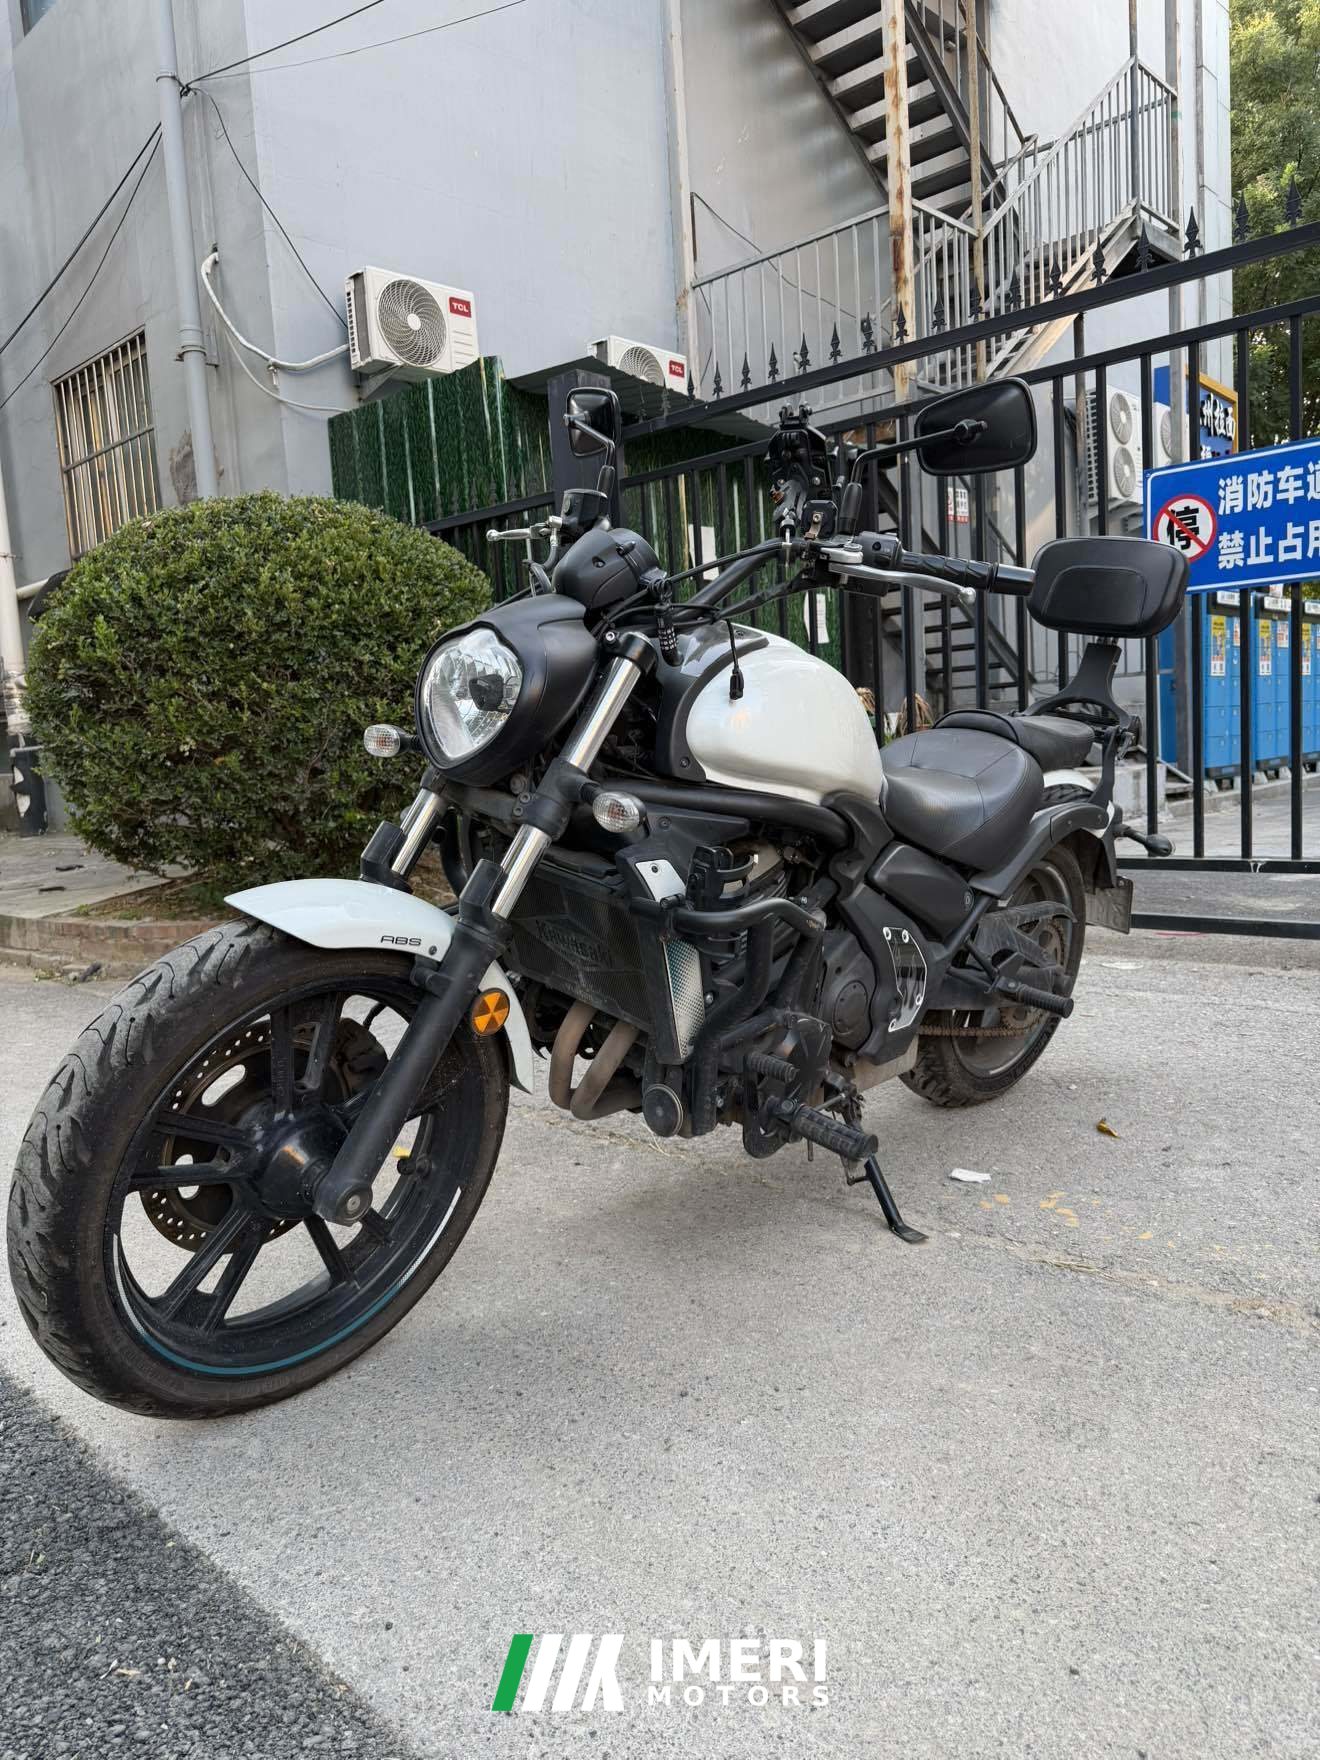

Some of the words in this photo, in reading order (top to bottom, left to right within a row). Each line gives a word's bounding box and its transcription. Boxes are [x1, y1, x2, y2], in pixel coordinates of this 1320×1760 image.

[451, 302, 469, 313] TCL
[671, 364, 684, 374] TCL
[1200, 392, 1236, 441] 州拉面
[380, 935, 422, 946] ABS
